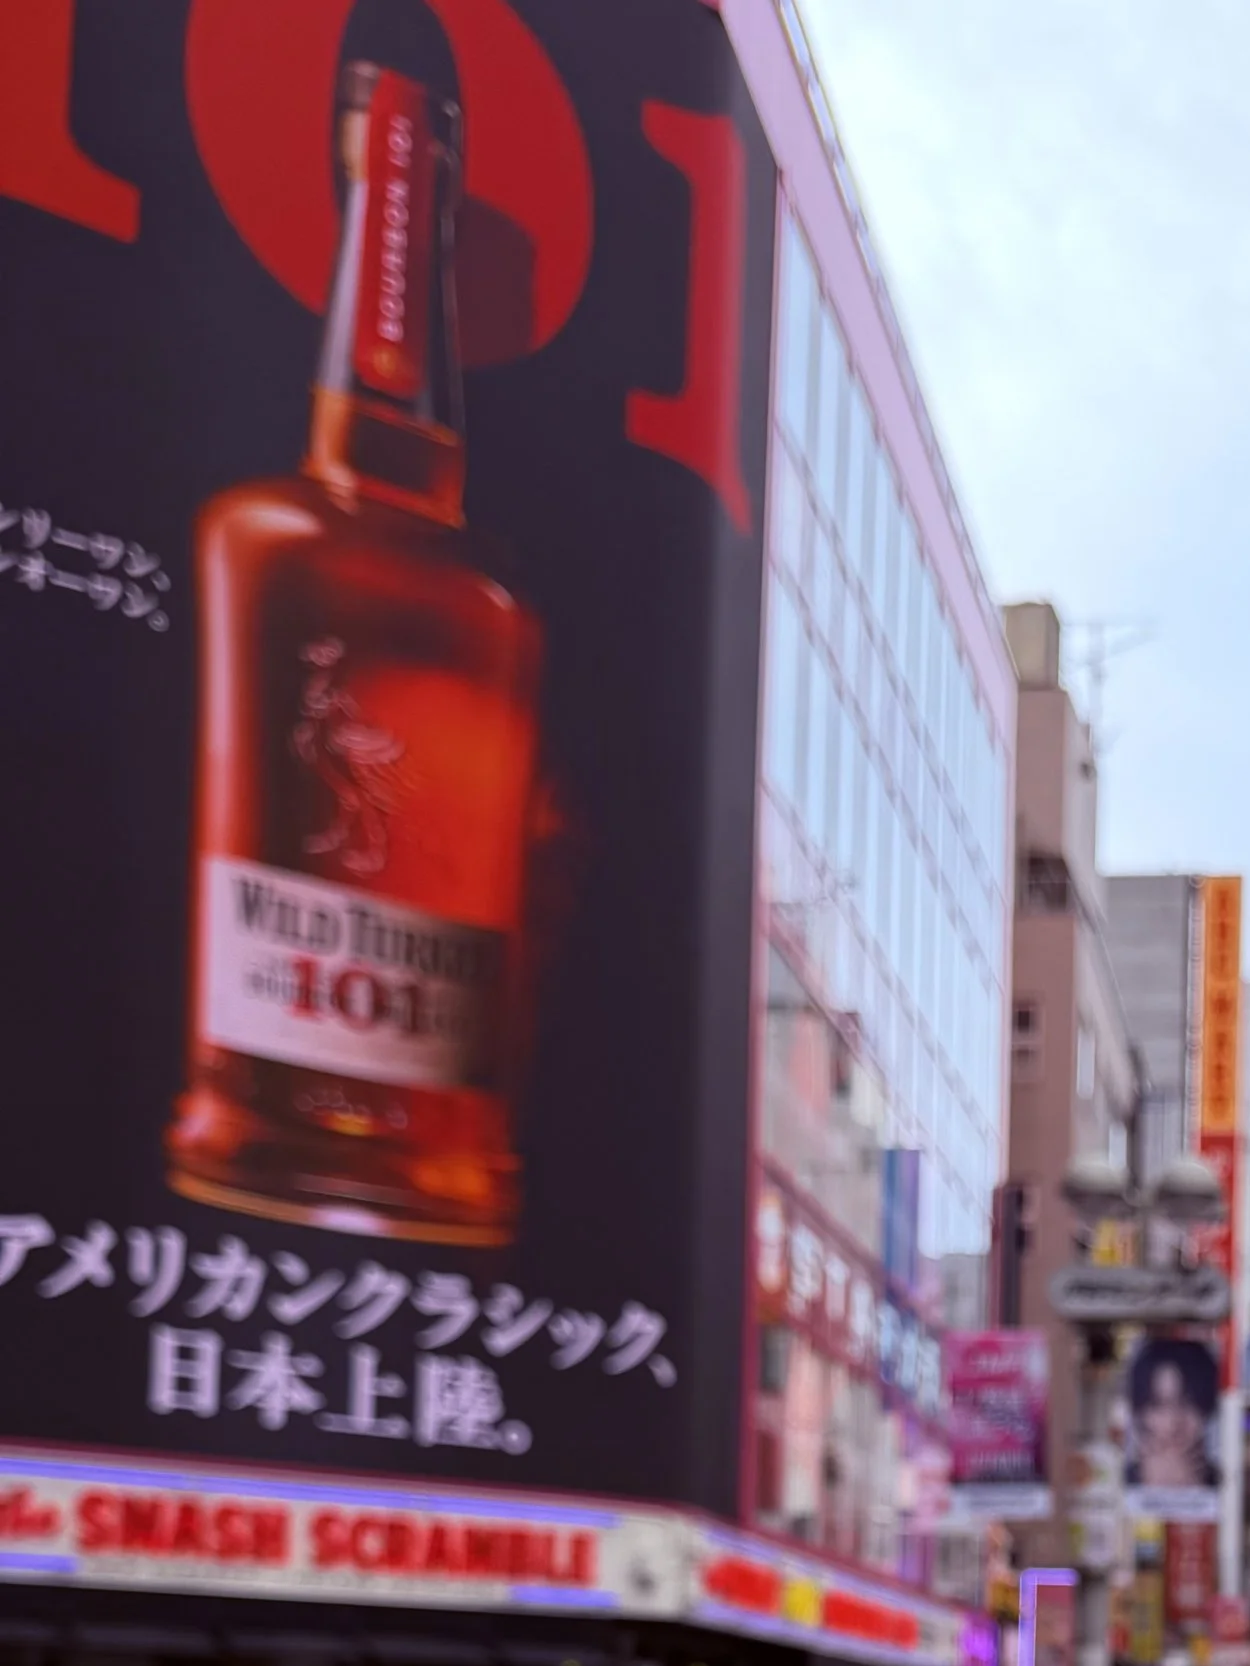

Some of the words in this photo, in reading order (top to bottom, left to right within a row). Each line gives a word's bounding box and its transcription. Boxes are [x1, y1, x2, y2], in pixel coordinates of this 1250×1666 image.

[387, 114, 413, 169] 101
[377, 179, 410, 342] BOURBON
[232, 874, 343, 953] WILD
[346, 903, 492, 978] TURKE
[290, 953, 424, 1038] 101
[0, 1214, 676, 1386] アメリカンクラシック、
[148, 1323, 532, 1456] 日本上陸。
[75, 1491, 291, 1566] SMASH
[311, 1508, 598, 1584] SCRAMBLE
